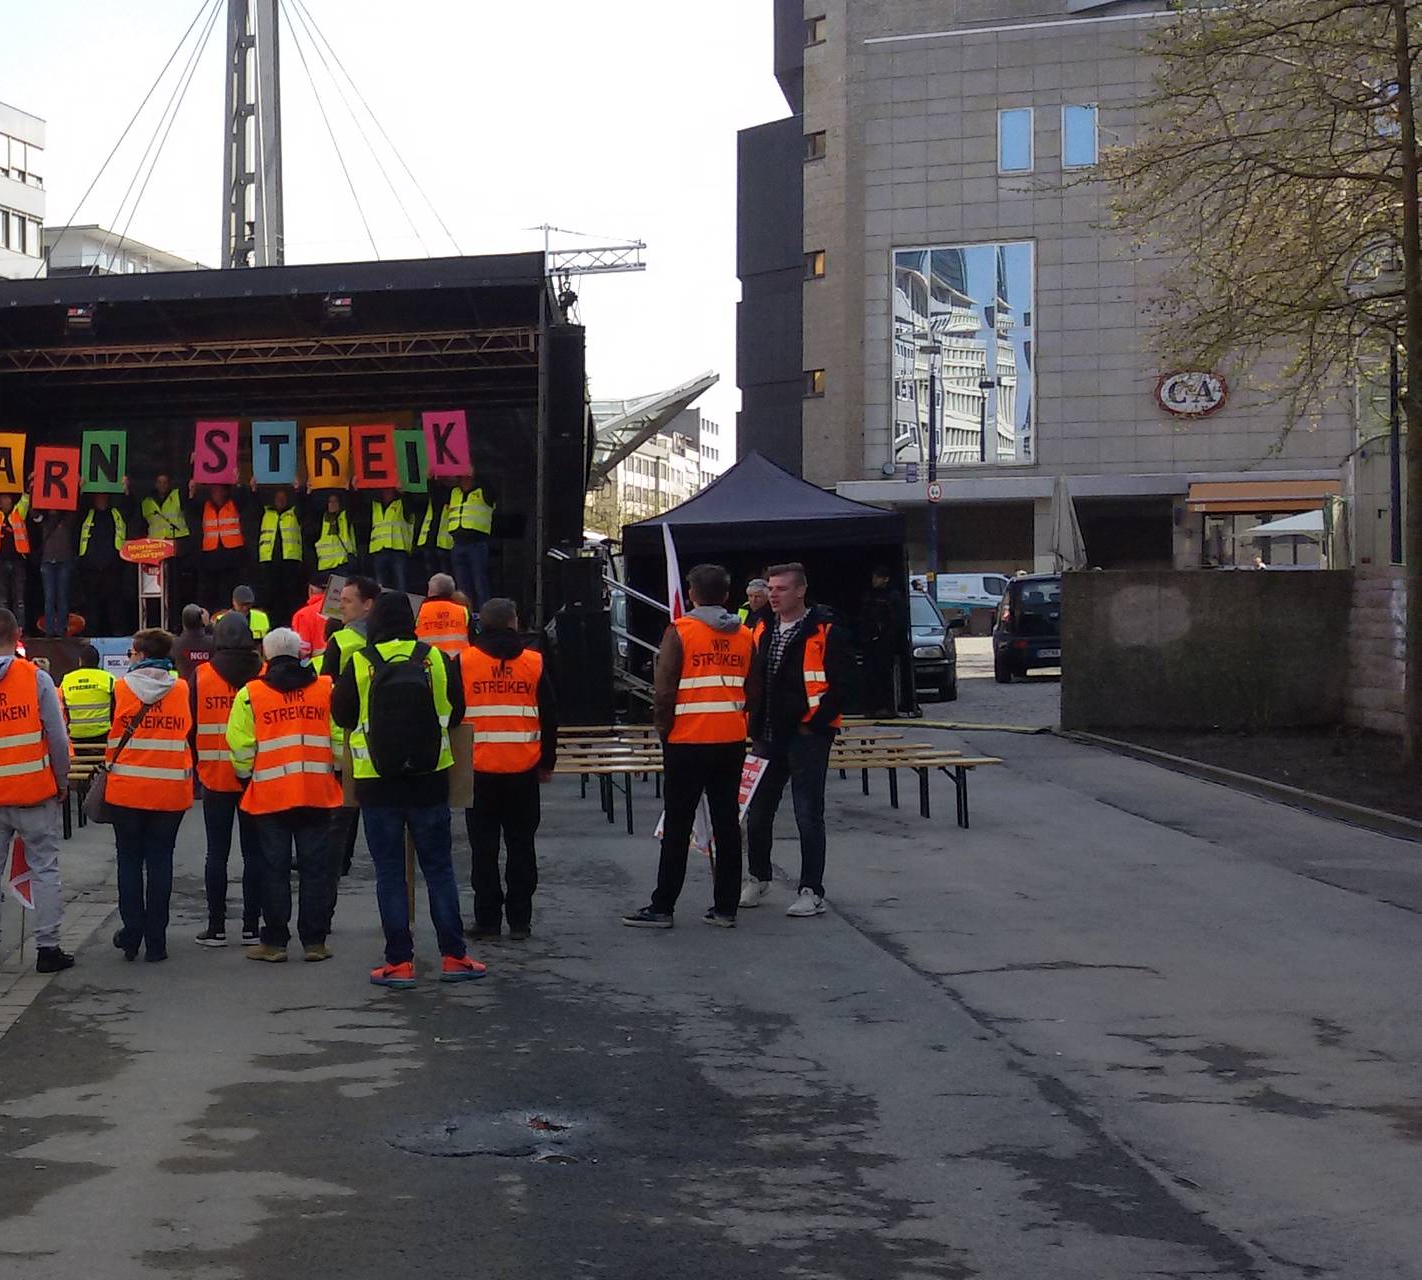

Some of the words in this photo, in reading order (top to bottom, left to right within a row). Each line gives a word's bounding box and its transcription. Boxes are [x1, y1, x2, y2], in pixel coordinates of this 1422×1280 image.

[202, 422, 460, 484] STREIK
[712, 639, 730, 652] WIR
[491, 665, 514, 680] WIR
[282, 690, 305, 705] WIR
[263, 705, 325, 726] STREIKEN!
